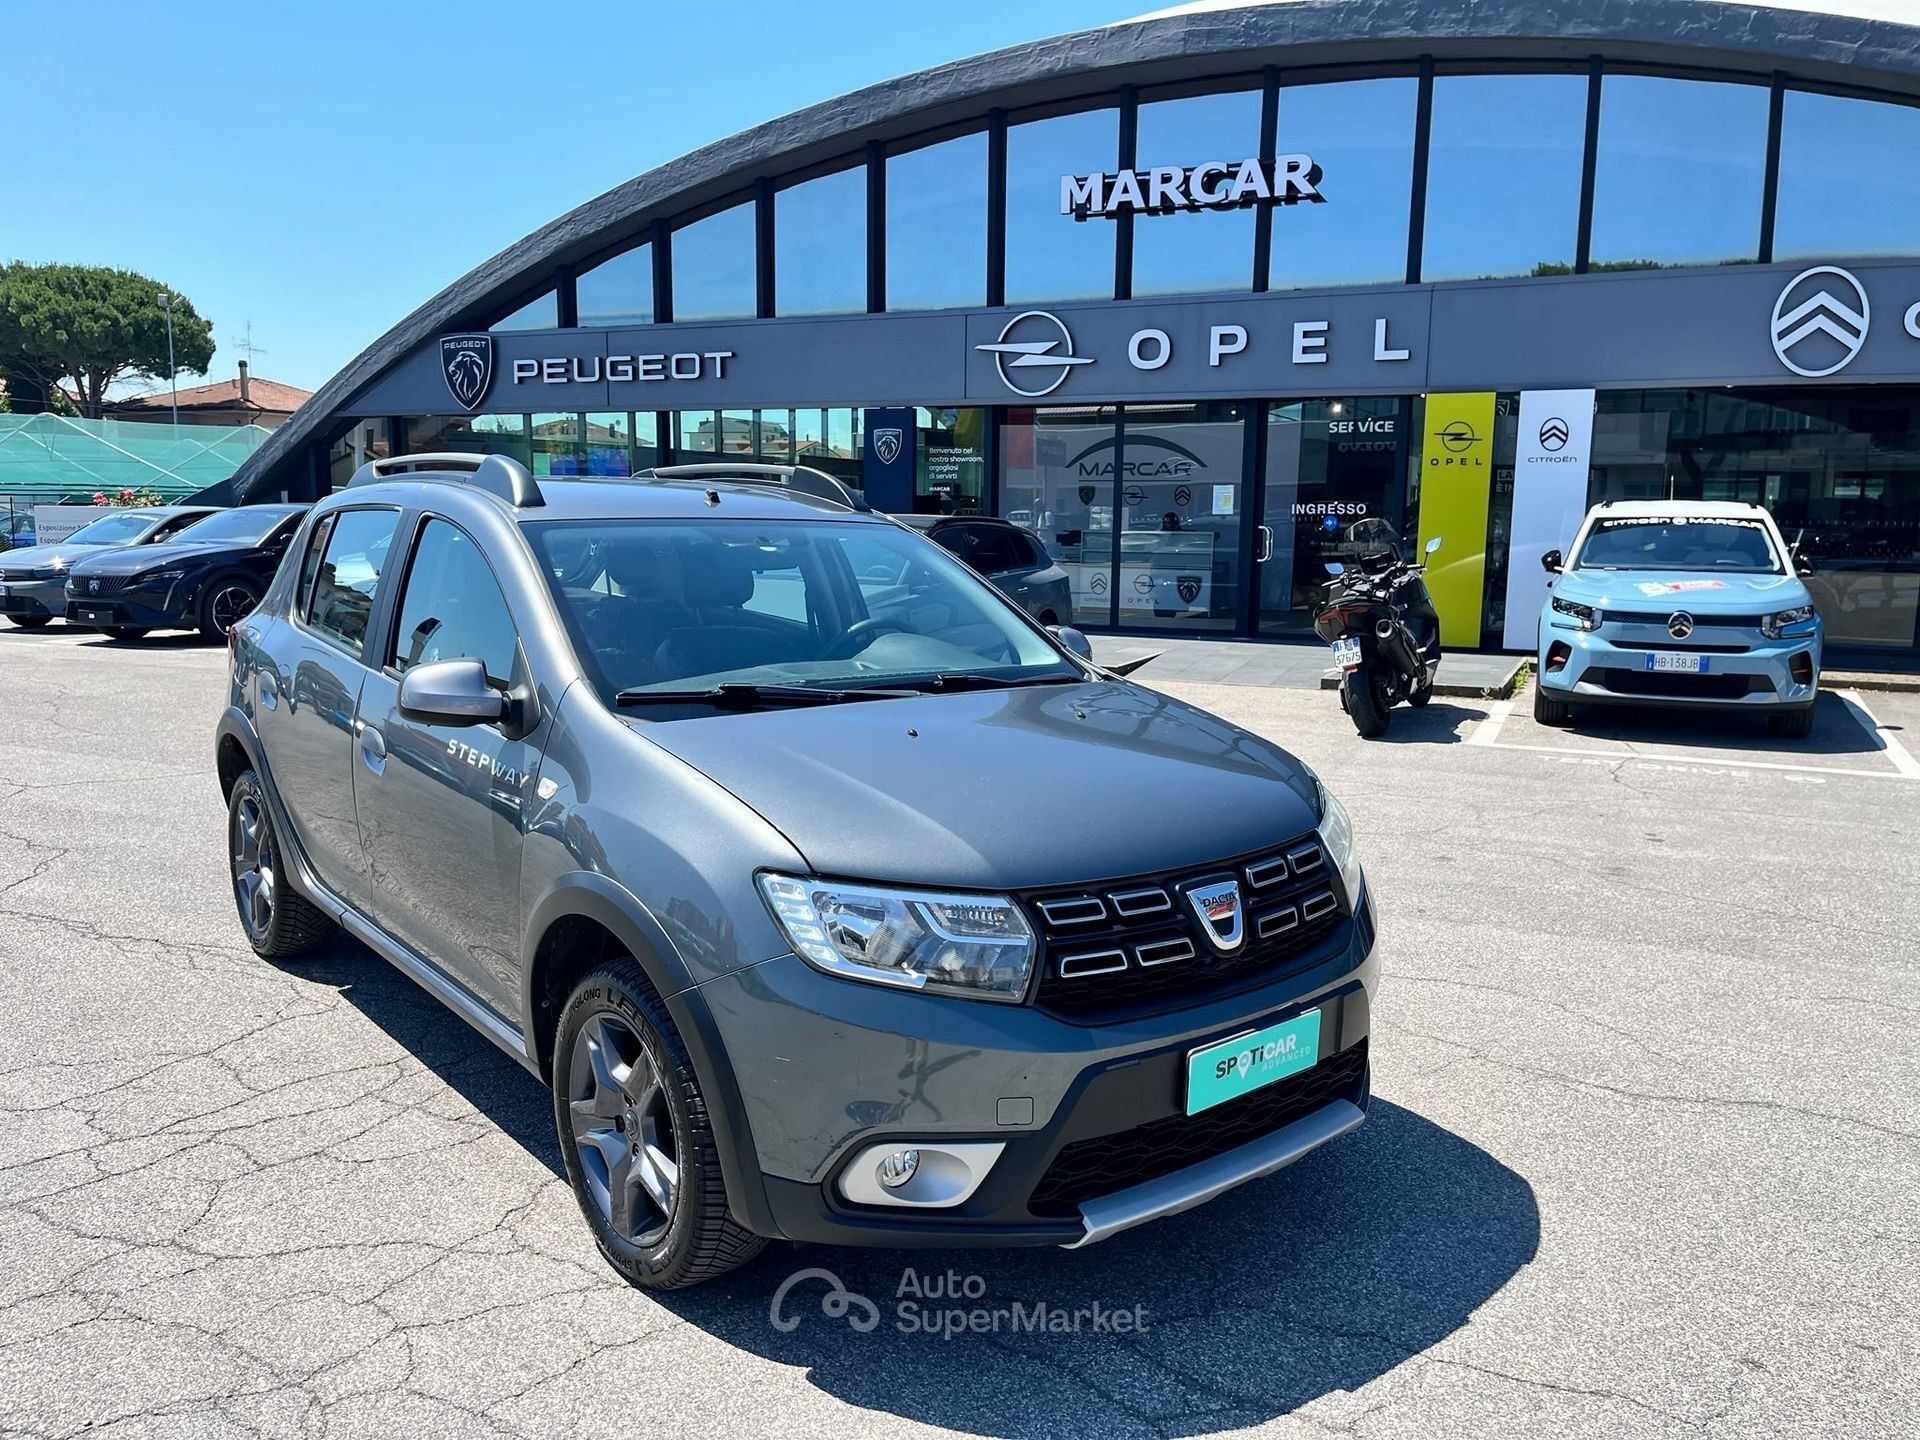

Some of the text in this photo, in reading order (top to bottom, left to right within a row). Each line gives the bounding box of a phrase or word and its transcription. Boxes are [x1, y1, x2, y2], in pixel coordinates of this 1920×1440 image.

[1060, 153, 1318, 215] MARCAR
[443, 340, 487, 350] PEUGEOT
[1128, 318, 1410, 370] OPEL
[513, 351, 733, 385] PEUGEOT
[1079, 462, 1192, 477] MARCAR
[1430, 457, 1483, 467] OPEL
[1291, 503, 1367, 515] INGRESSO
[447, 738, 530, 788] STEPWAY
[1202, 892, 1236, 908] DACIA
[1262, 1045, 1311, 1073] ADVANCED
